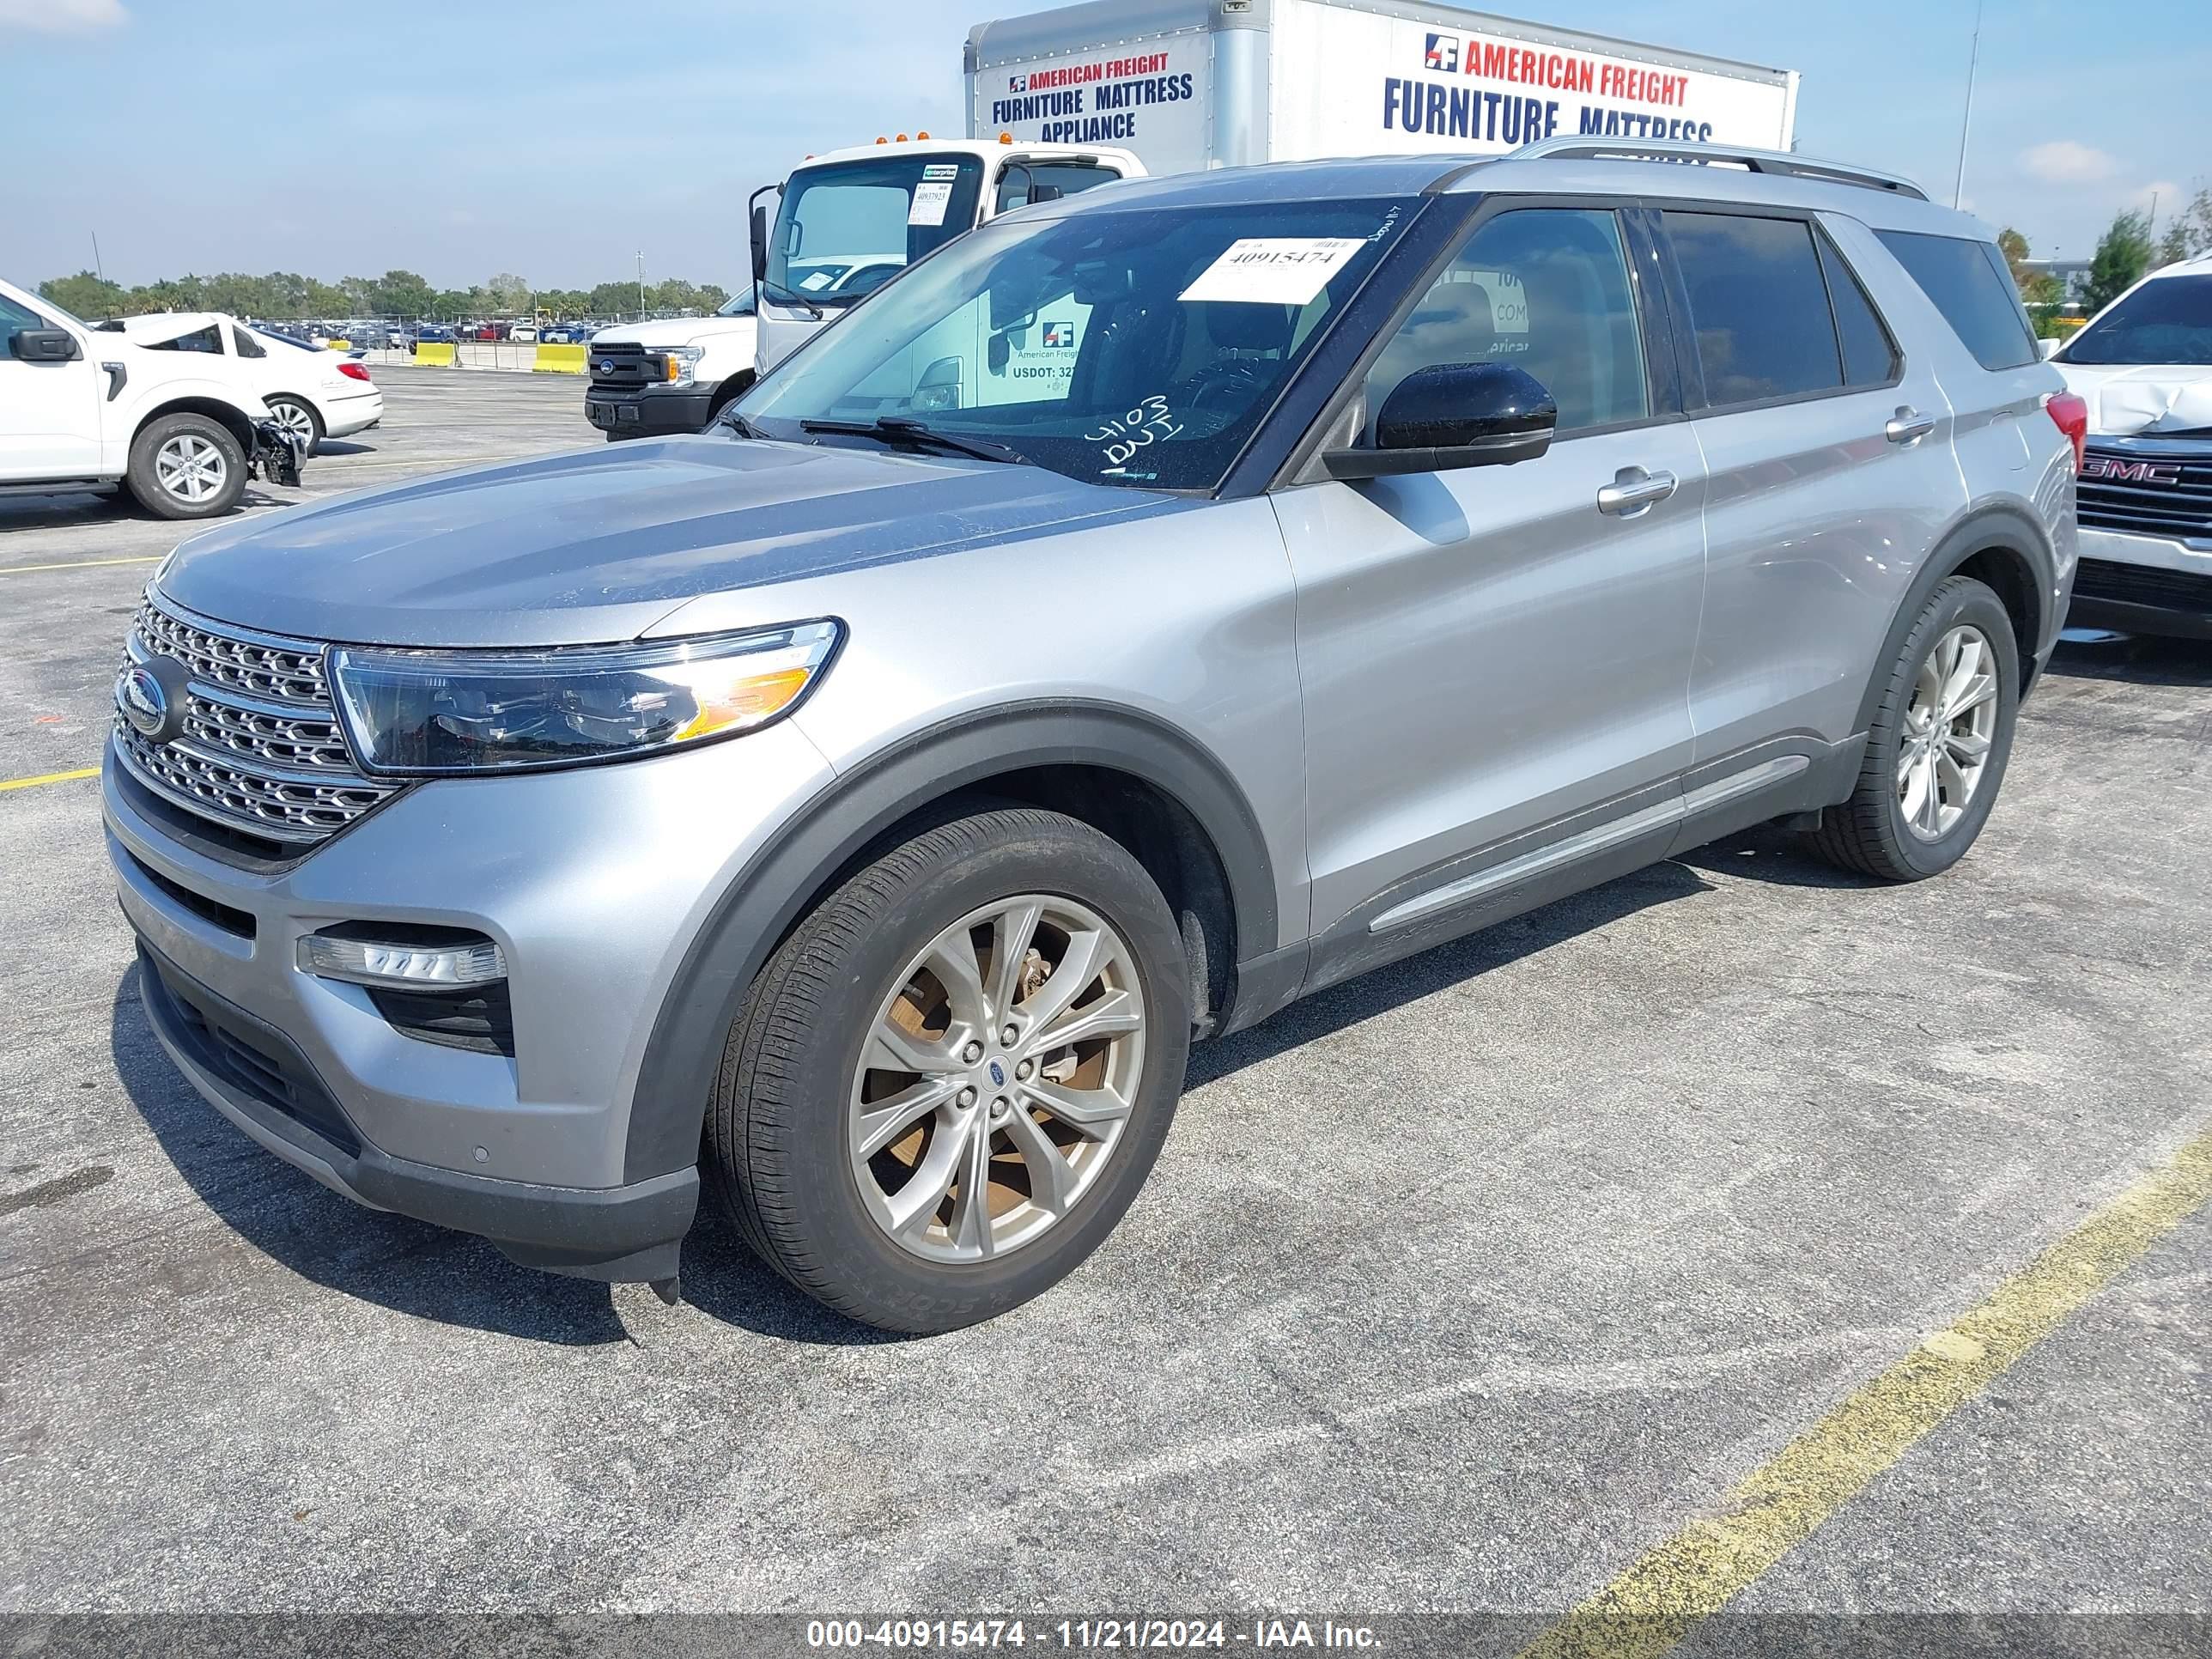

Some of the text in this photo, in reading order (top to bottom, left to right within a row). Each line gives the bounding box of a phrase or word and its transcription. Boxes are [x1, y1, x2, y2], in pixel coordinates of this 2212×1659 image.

[1029, 63, 1103, 91] AMERICAN
[1105, 52, 1169, 79] FREIGHT
[1465, 40, 1595, 93] AMERICAN
[1600, 64, 1688, 107] FREIGHT
[993, 73, 1193, 125] FURNITURE MATTRESS
[1383, 77, 1559, 144] FURNITURE
[1042, 112, 1135, 143] APPLIANCE
[925, 168, 956, 177] enterprise
[1230, 252, 1336, 264] 40915474
[1497, 304, 1526, 320] COM
[1018, 350, 1054, 359] American
[1013, 368, 1055, 378] USDOT:
[2081, 458, 2181, 484] GMC
